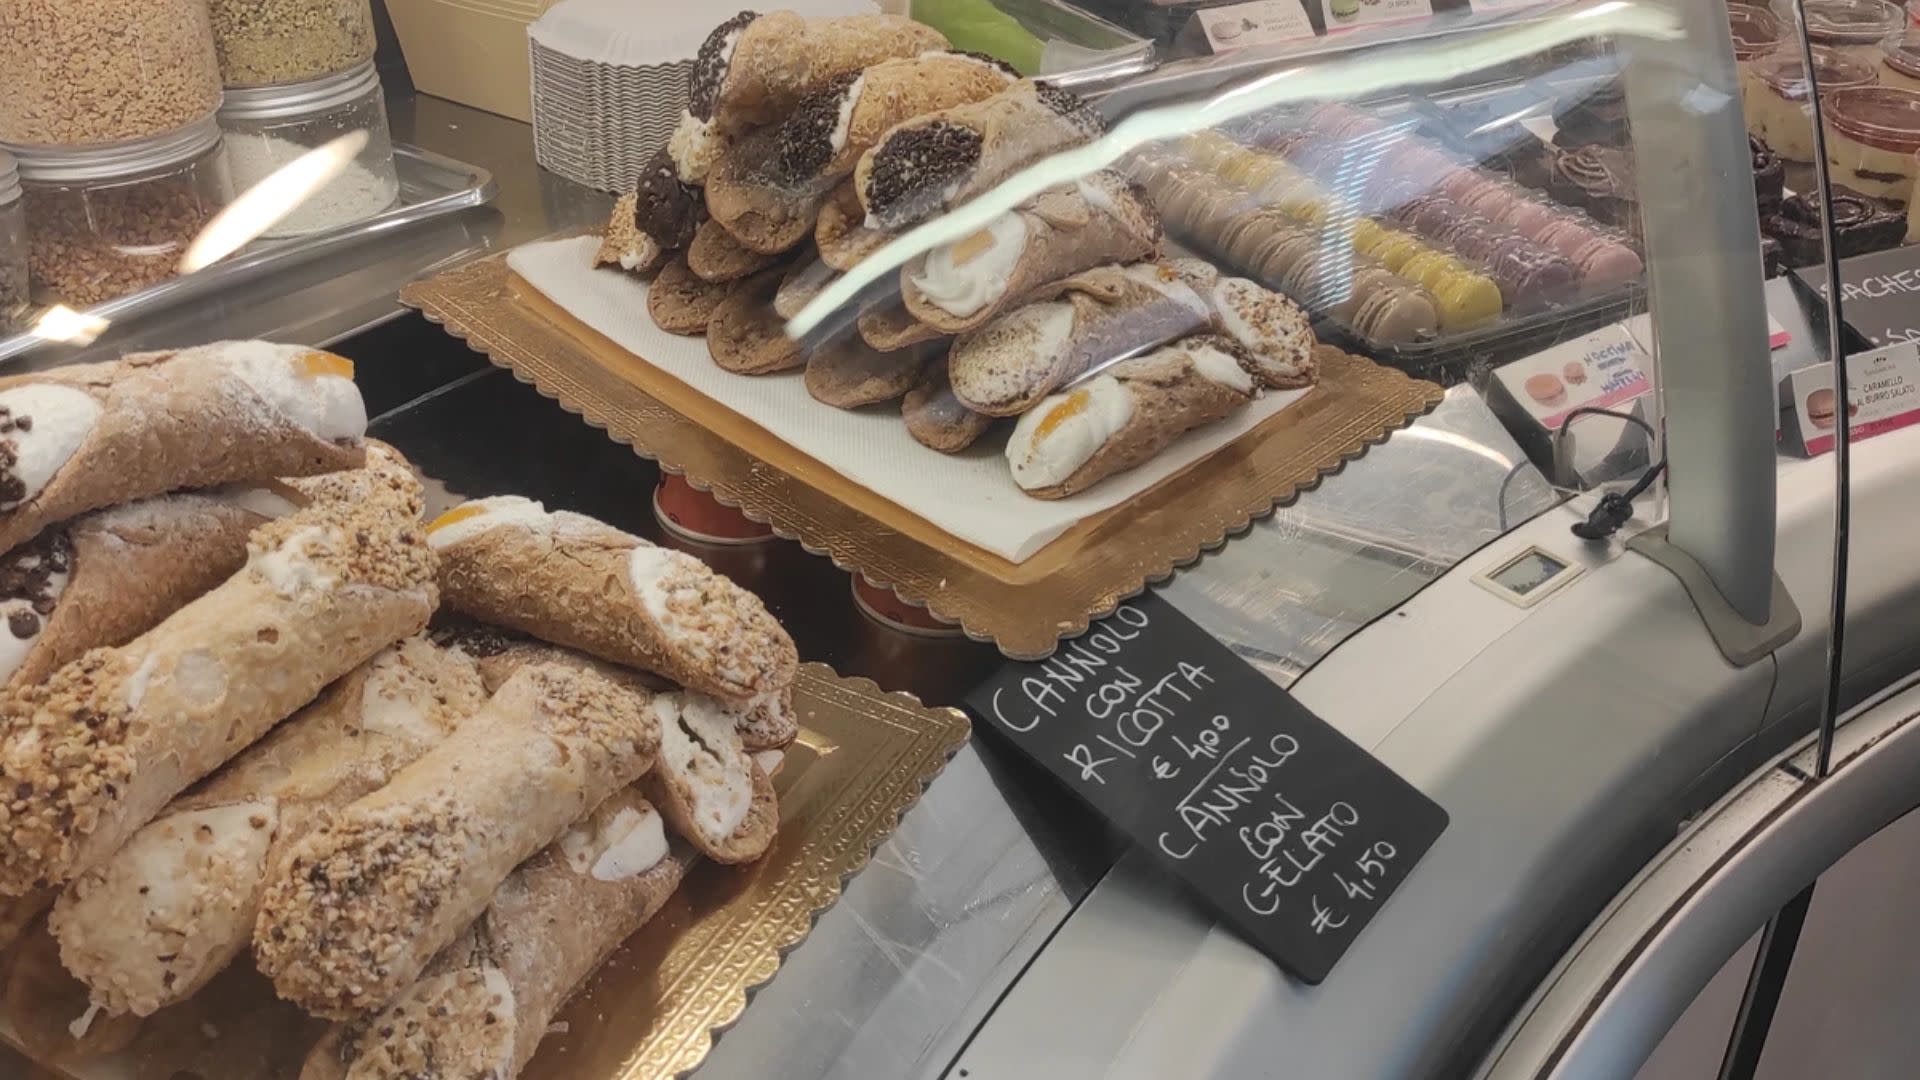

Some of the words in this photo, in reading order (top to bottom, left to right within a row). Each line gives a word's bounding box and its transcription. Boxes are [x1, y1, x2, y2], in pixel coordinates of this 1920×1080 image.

[993, 605, 1149, 732] CANNOLO
[1064, 661, 1215, 785] RICOTTA
[1086, 666, 1143, 718] CON
[1158, 734, 1299, 859] CANNOLO
[1239, 794, 1305, 859] CON
[1243, 802, 1359, 915] GELATO
[1333, 840, 1397, 901] 4,50
